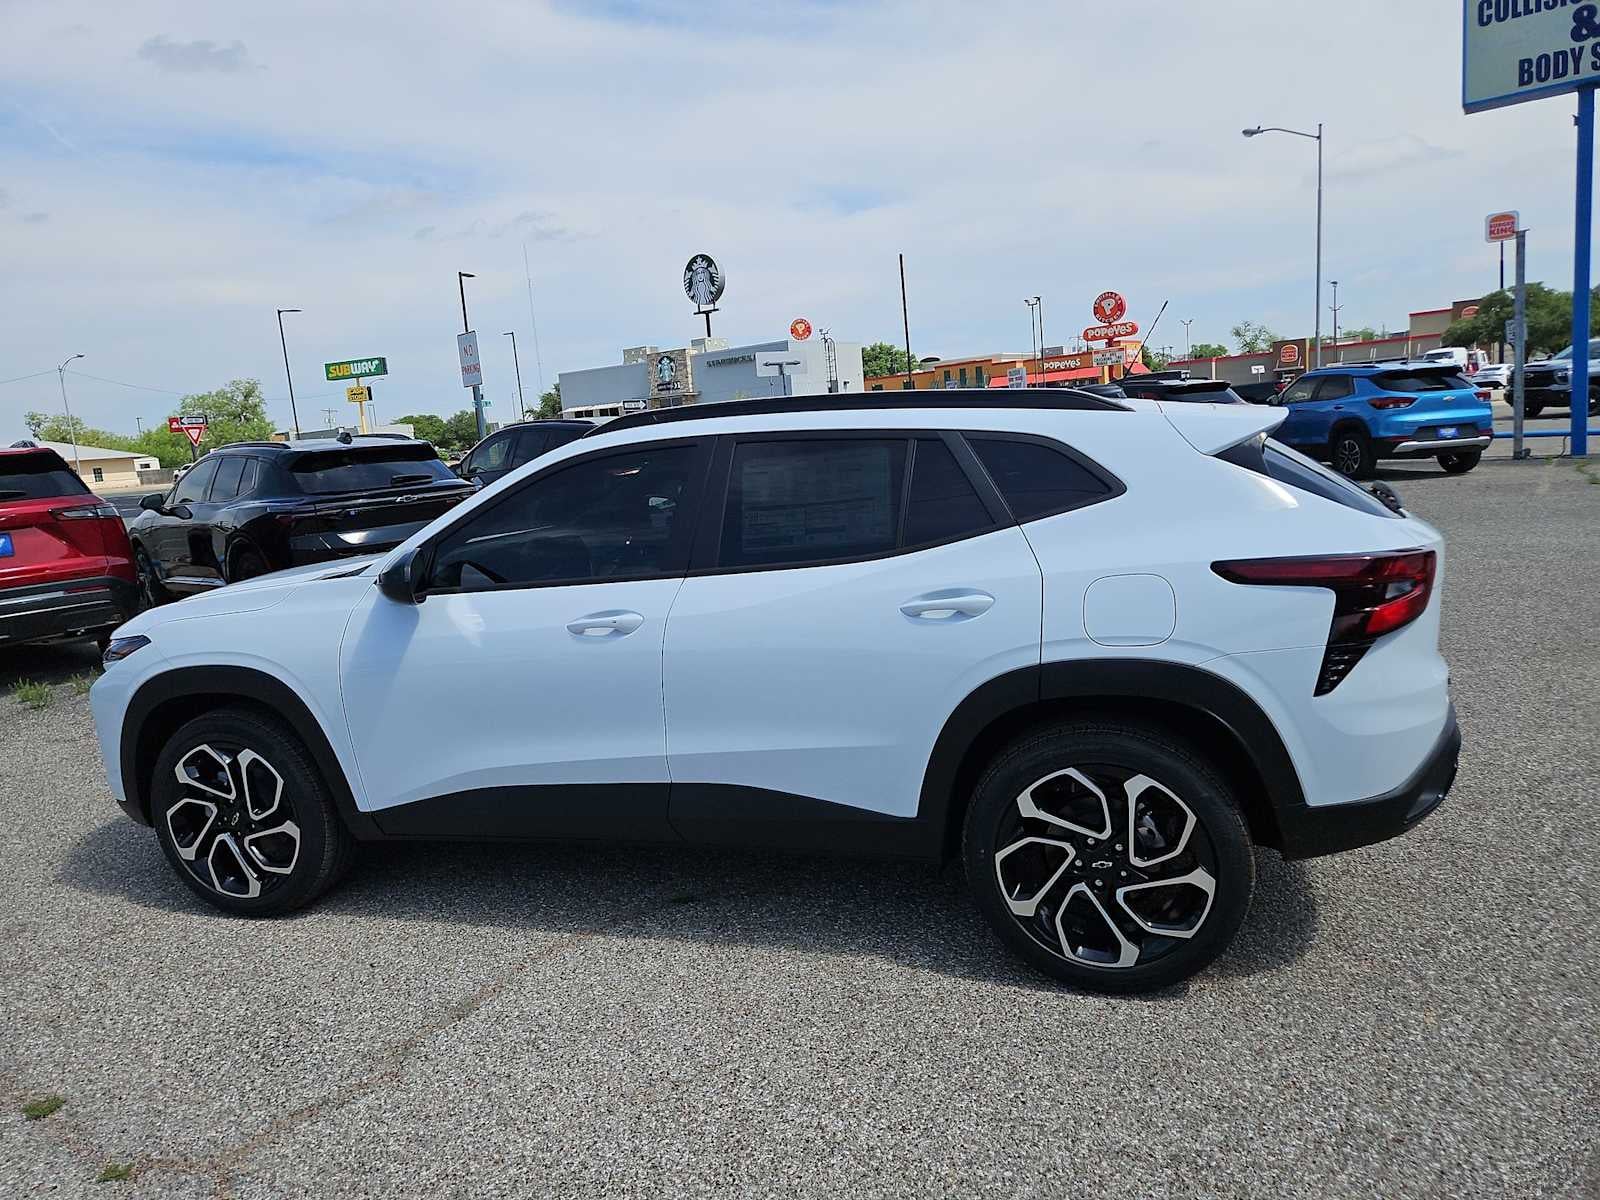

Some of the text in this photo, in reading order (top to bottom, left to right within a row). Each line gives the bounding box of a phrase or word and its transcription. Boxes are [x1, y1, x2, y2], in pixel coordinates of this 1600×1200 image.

[1570, 4, 1600, 42] &
[1518, 45, 1585, 87] BODY
[1489, 226, 1515, 236] KING
[463, 344, 474, 357] NO
[328, 360, 379, 377] SUBWAY
[461, 363, 481, 376] PARKING
